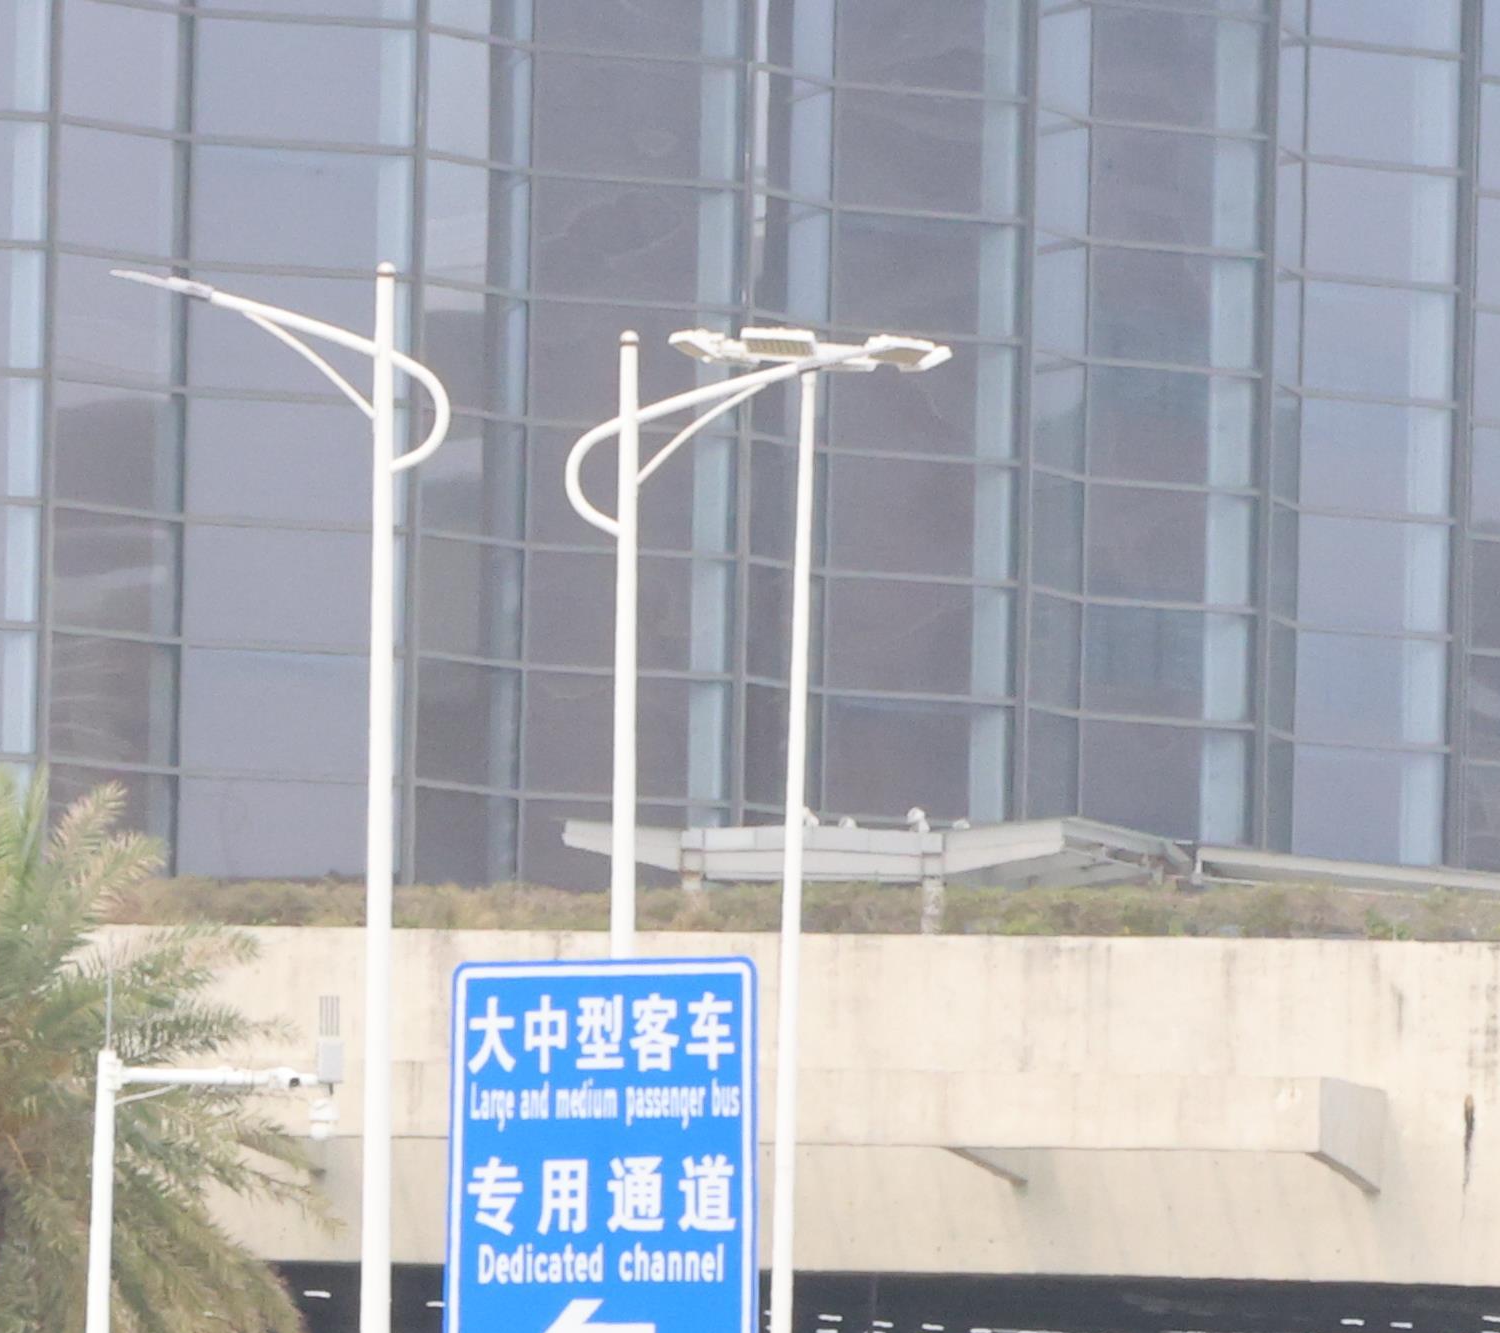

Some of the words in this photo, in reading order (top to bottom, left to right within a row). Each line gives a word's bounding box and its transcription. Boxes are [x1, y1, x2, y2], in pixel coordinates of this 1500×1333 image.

[467, 992, 736, 1074] 大中型客车
[470, 1081, 515, 1131] Large
[520, 1080, 550, 1119] and
[555, 1077, 618, 1119] medium
[625, 1084, 706, 1130] passenger
[711, 1077, 741, 1117] bus
[467, 1155, 737, 1236] 专用通道
[478, 1243, 604, 1284] Dedicated
[618, 1243, 725, 1283] channel
